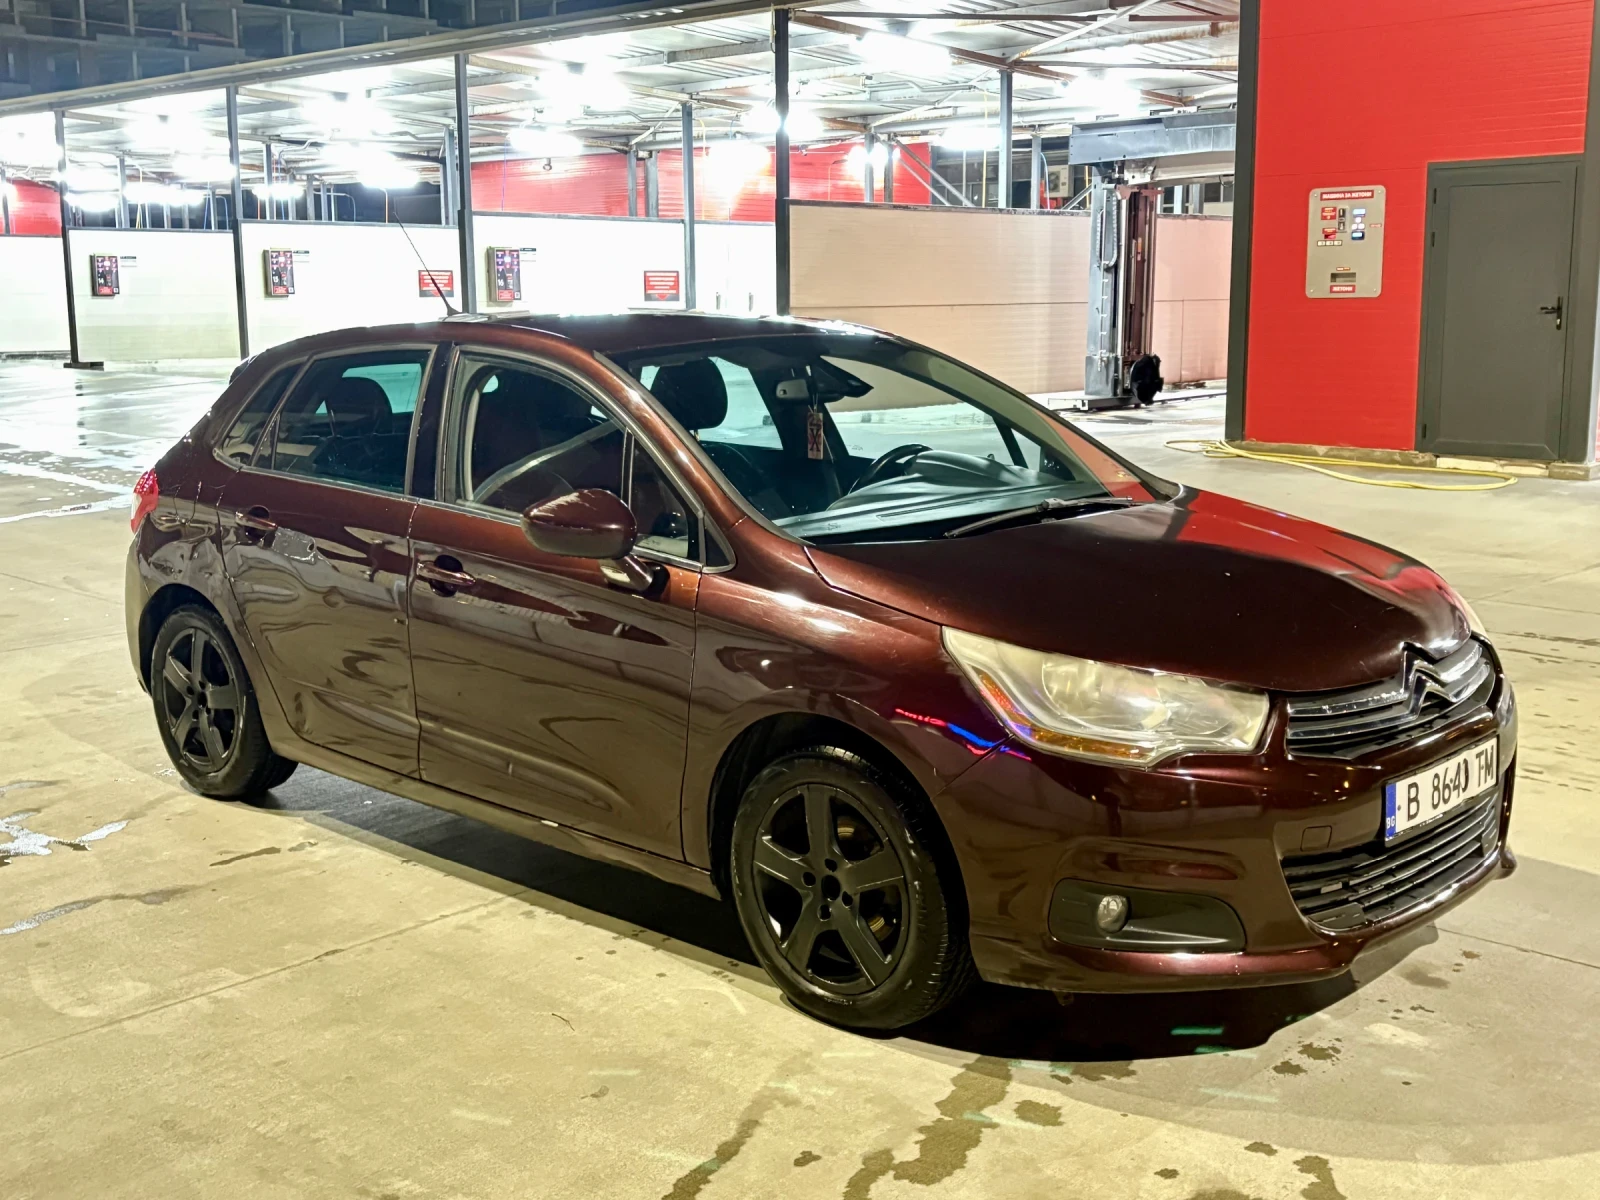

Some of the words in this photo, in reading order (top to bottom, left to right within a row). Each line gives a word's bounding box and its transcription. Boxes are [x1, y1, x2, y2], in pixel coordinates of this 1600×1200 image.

[1407, 781, 1420, 822] B
[1475, 745, 1495, 788] TM
[1386, 815, 1396, 829] BG
